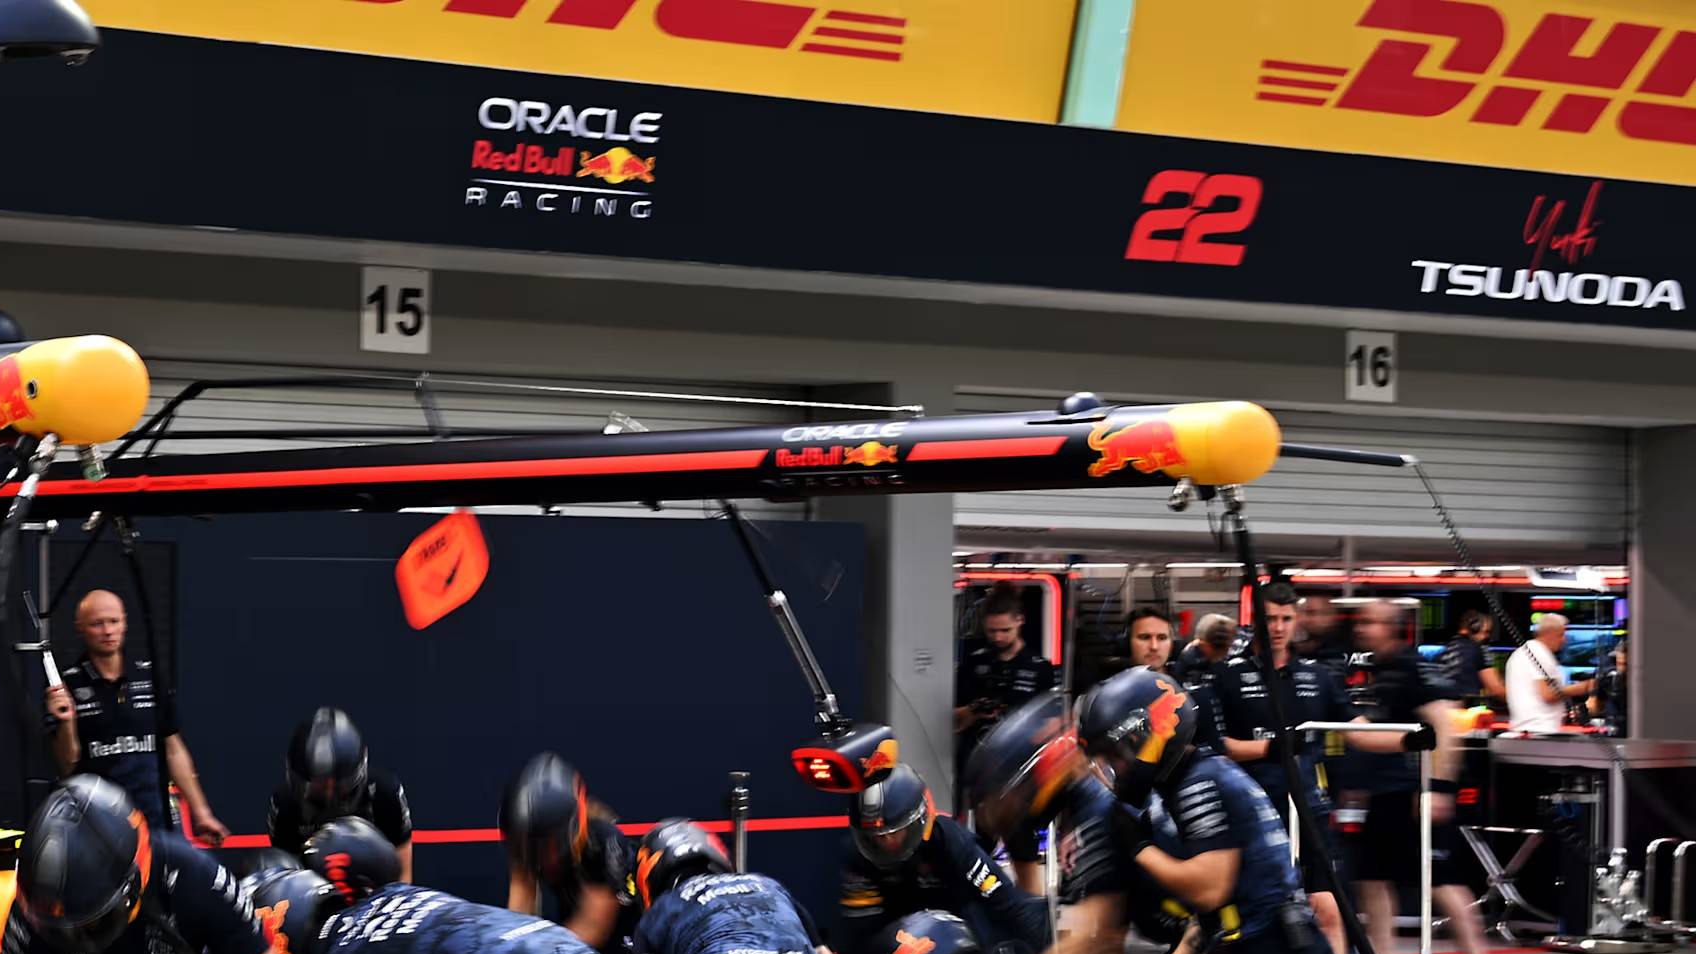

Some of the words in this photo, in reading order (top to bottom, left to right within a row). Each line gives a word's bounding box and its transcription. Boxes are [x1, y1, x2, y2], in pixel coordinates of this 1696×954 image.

[478, 97, 663, 143] ORACLE
[465, 186, 653, 219] RACING
[1124, 168, 1264, 267] 22
[1411, 259, 1686, 311] TSUNODA
[366, 284, 425, 337] 15
[1349, 344, 1392, 388] 16
[781, 421, 910, 443] ORACLE
